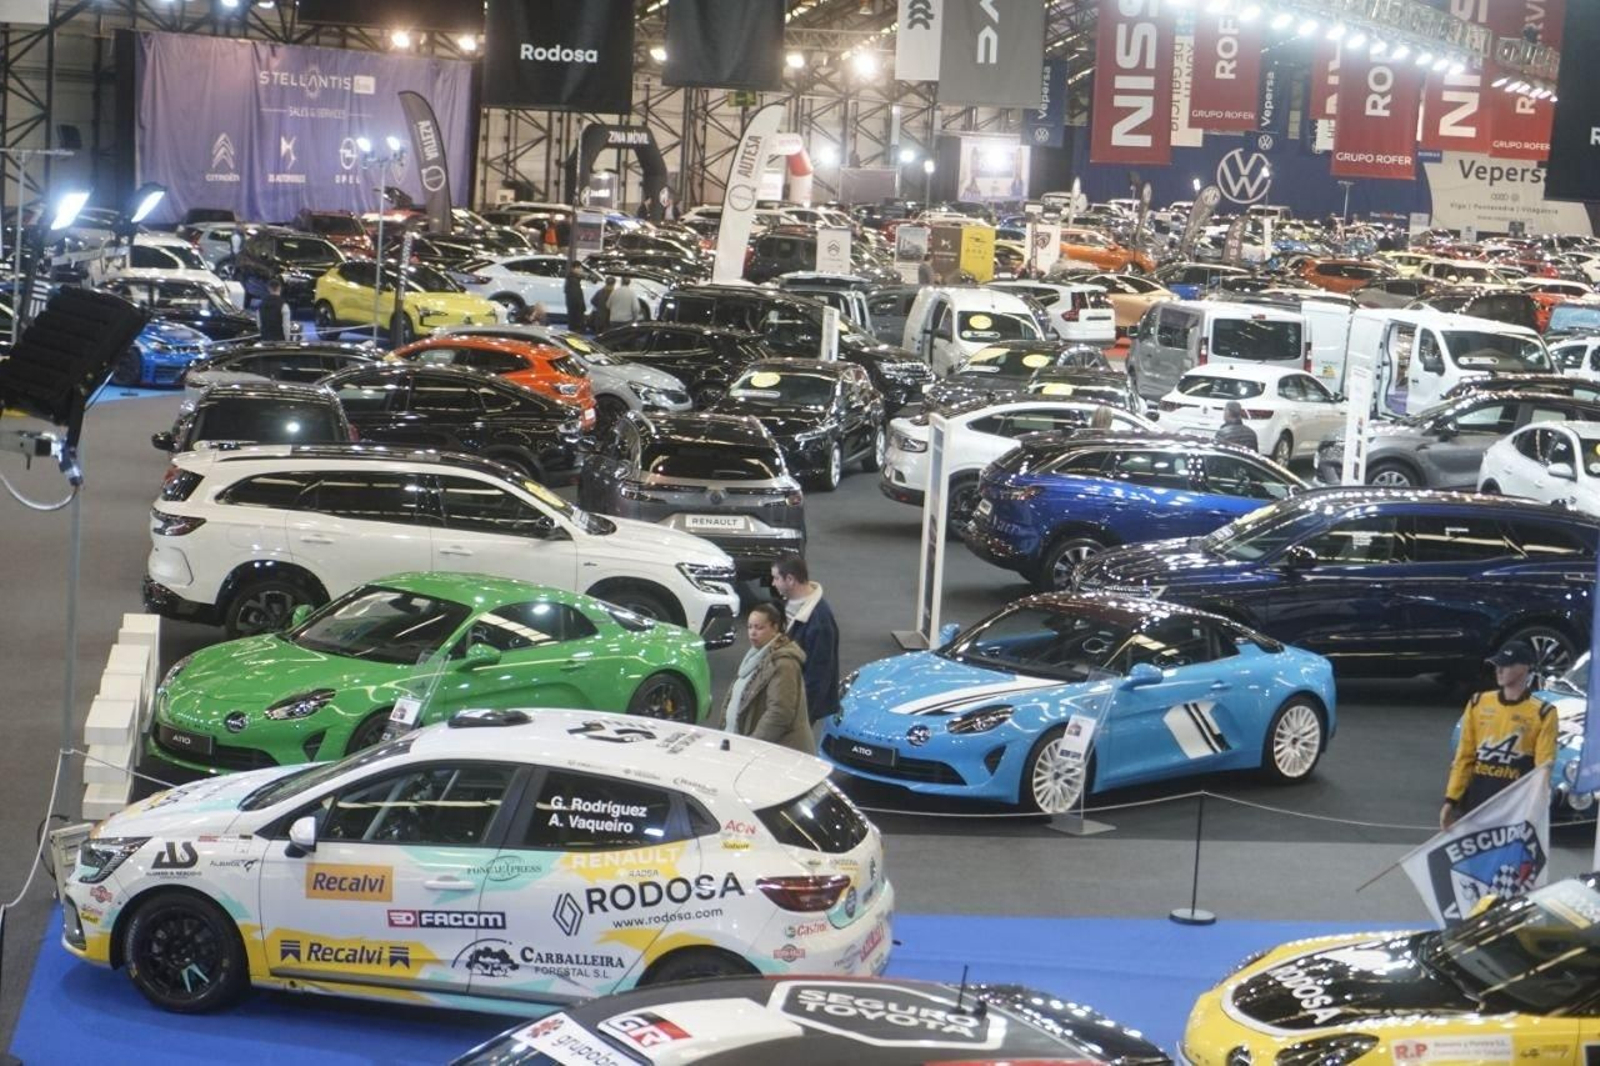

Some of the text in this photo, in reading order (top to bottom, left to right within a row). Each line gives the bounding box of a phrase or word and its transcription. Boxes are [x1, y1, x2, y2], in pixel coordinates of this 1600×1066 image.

[520, 43, 598, 64] Rodosa
[259, 71, 351, 91] STELLANTIS
[1261, 71, 1275, 127] Vepersa
[1492, 140, 1522, 149] GRUPO
[737, 135, 762, 178] AUTESA
[1335, 151, 1374, 163] GRUPO
[1376, 154, 1413, 166] ROFER
[691, 518, 736, 526] RENAULT
[172, 734, 192, 745] A110
[851, 745, 873, 756] A110
[550, 796, 648, 818] G. Rodríguez
[548, 813, 634, 834] A. Vaqueiro
[571, 849, 680, 869] RENAULT
[313, 872, 385, 893] Recalvi
[585, 872, 746, 915] RODOSA
[420, 912, 504, 928] FACOM
[613, 907, 724, 930] www.rodosa.com
[307, 942, 383, 965] Recalvi
[534, 965, 590, 978] FORESTAL
[1266, 964, 1342, 1025] RODOSA
[797, 989, 981, 1028] SEGURO
[800, 999, 975, 1039] TOYOTA
